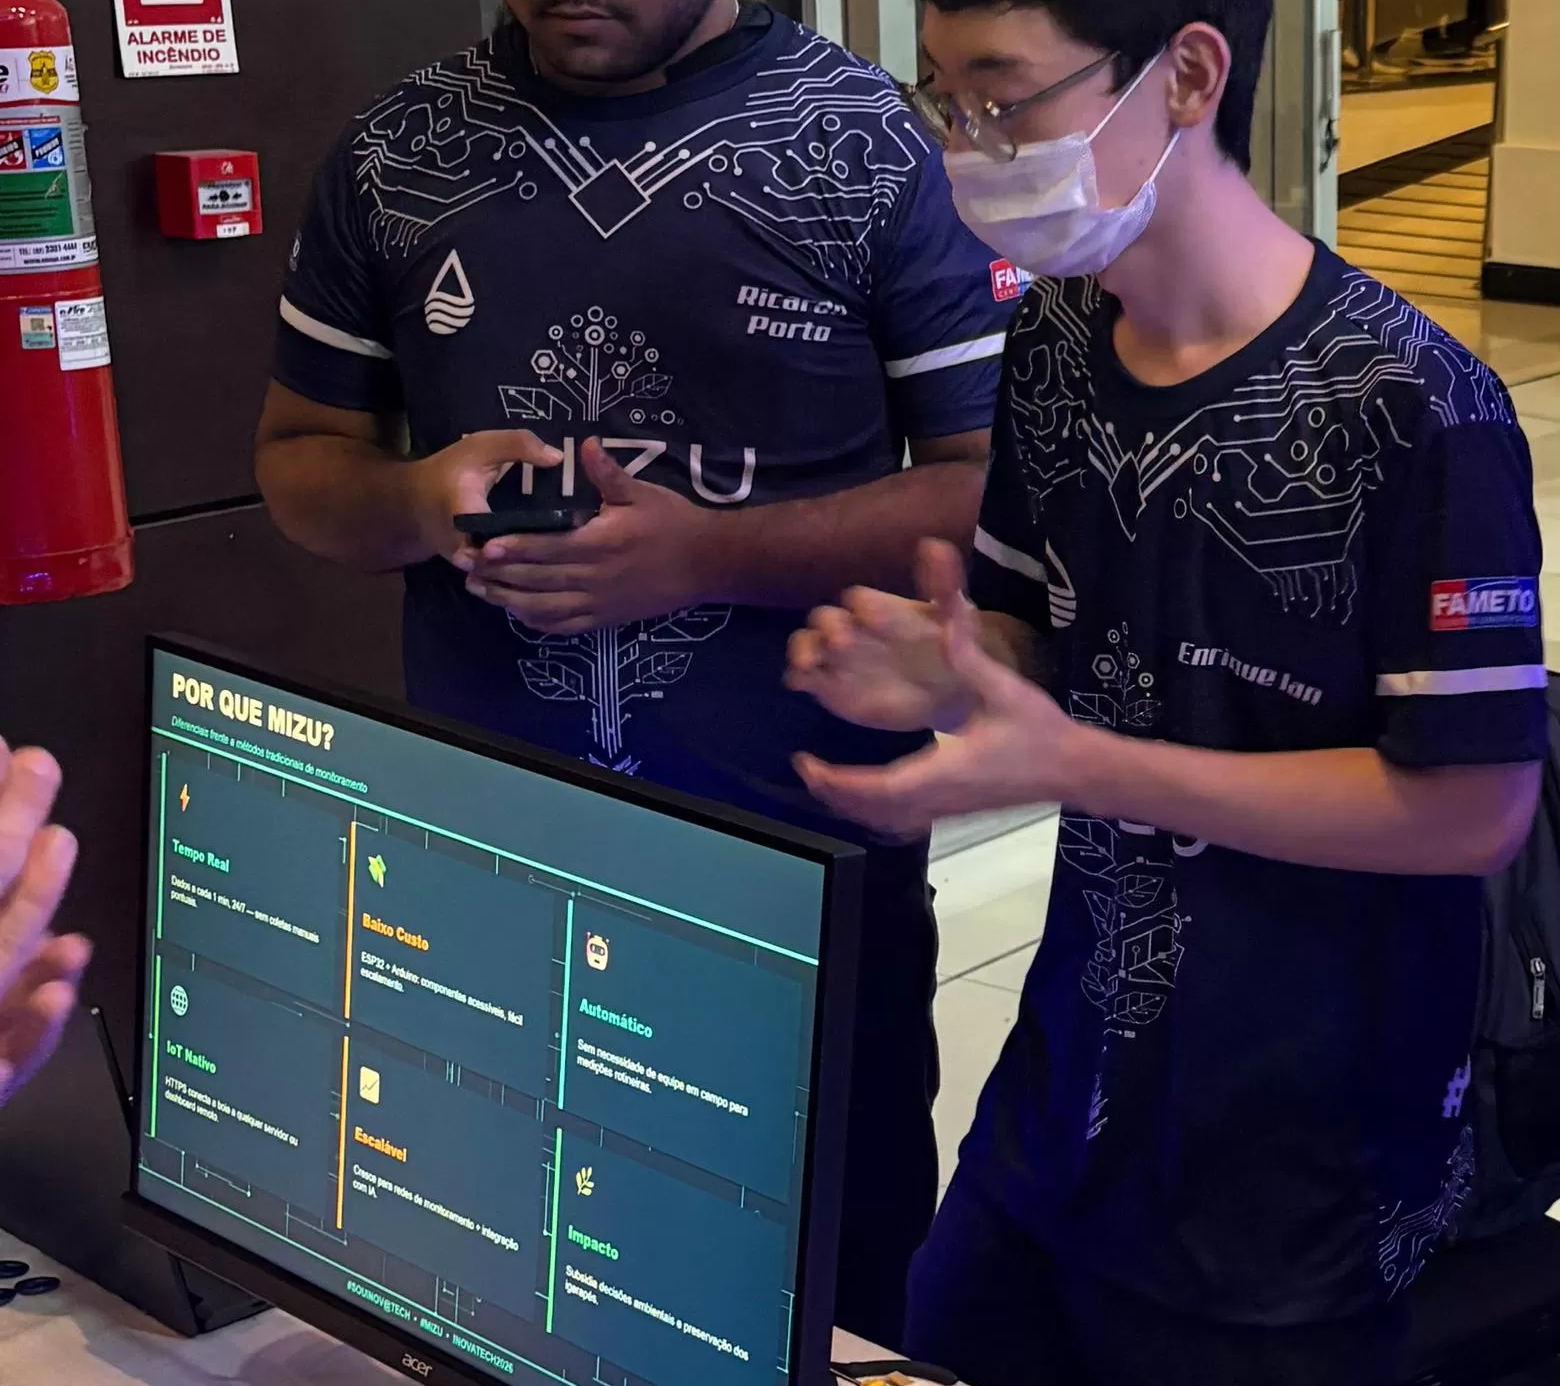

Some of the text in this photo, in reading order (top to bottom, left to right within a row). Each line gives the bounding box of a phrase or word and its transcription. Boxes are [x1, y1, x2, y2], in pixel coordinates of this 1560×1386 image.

[127, 29, 227, 46] ALARME DE
[137, 47, 220, 64] INCÊNDIO
[747, 315, 832, 341] Porto
[1178, 642, 1323, 706] Enrique Ian
[172, 673, 335, 750] POR QUE MIZU?
[172, 839, 230, 873] Tempo Real
[362, 913, 429, 951] Baixo Custo
[579, 998, 653, 1038] Automático
[185, 1048, 216, 1074] Nativo
[577, 1056, 613, 1078] medições
[578, 1038, 749, 1117] Sem necessidade equipe campo para
[354, 1126, 407, 1162] Escalável
[568, 1225, 619, 1260] Impacto
[599, 1281, 632, 1305] decisões
[633, 1298, 675, 1326] ambientais
[684, 1322, 732, 1353] preservação
[733, 1345, 749, 1361] dos
[402, 1354, 432, 1377] acer
